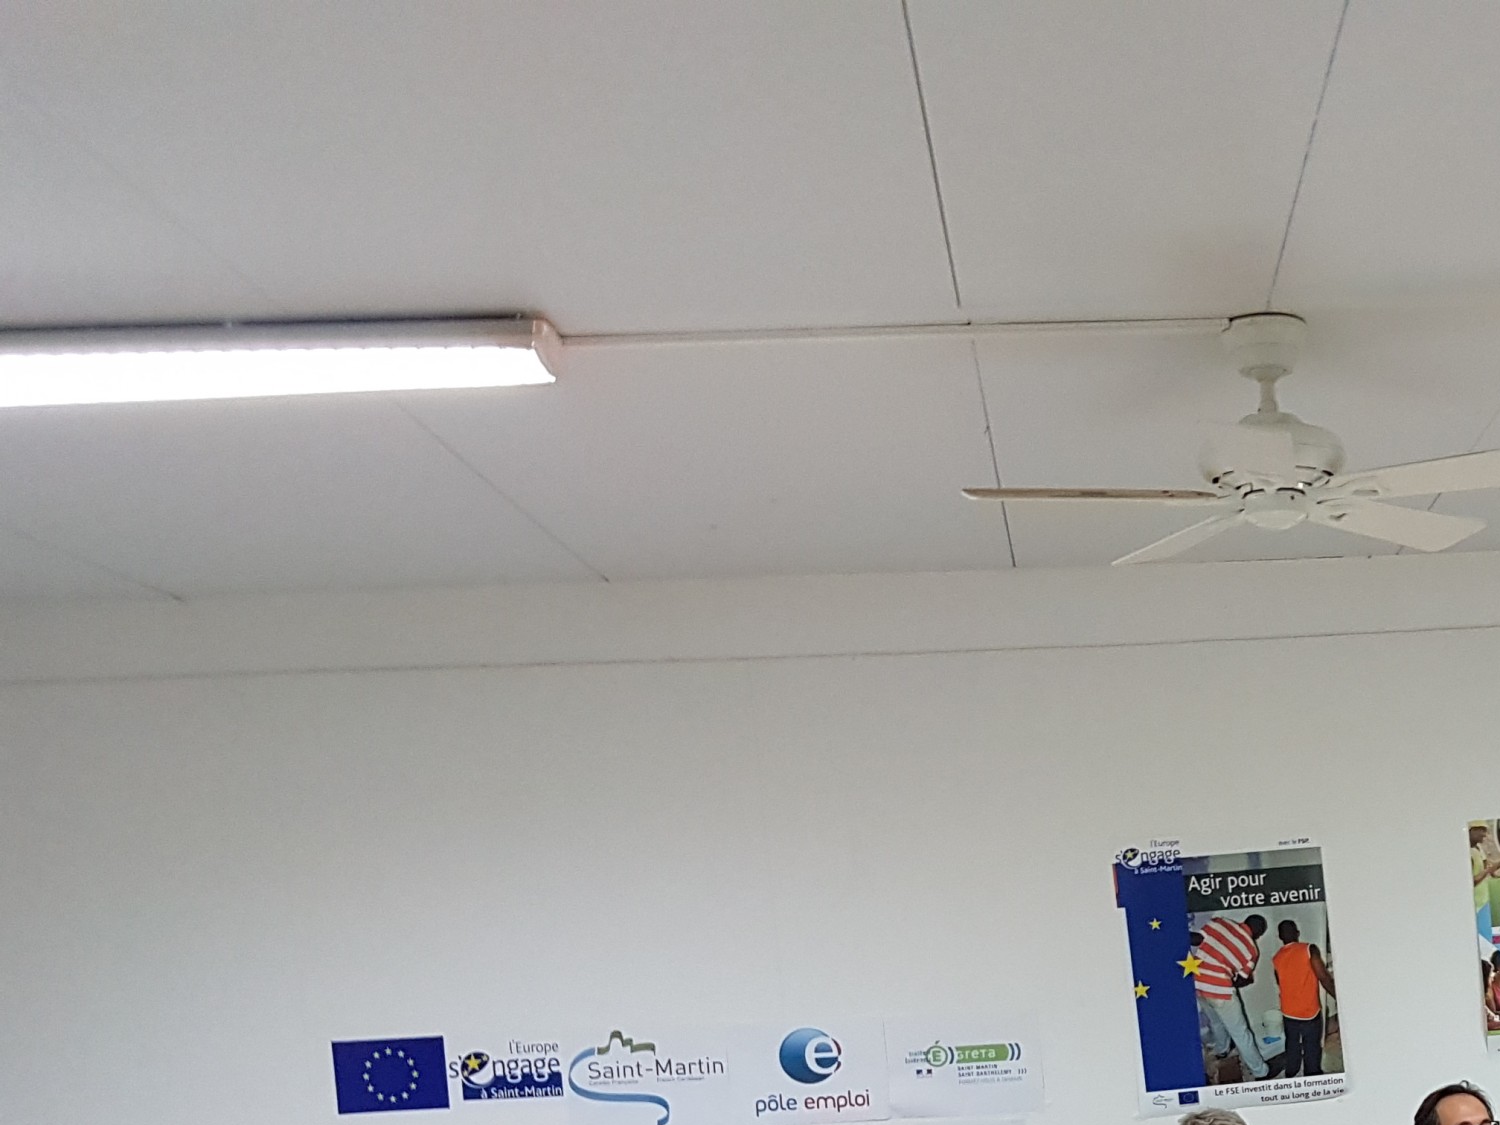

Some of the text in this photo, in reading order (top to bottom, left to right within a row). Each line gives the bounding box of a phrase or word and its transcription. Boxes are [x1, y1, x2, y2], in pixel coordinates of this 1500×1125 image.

[1188, 873, 1266, 895] Agir pour
[1220, 884, 1320, 908] votre avenir
[508, 1039, 559, 1056] l'Europe
[587, 1056, 724, 1080] Saint-Martin
[481, 1085, 563, 1099] à Saint-Martin
[1226, 1086, 1239, 1095] FSE
[1241, 1083, 1272, 1093] investit
[1274, 1081, 1292, 1091] dans
[1294, 1080, 1302, 1088] la
[1303, 1077, 1344, 1087] formation
[1292, 1092, 1309, 1100] long
[755, 1089, 870, 1117] pôle emploi
